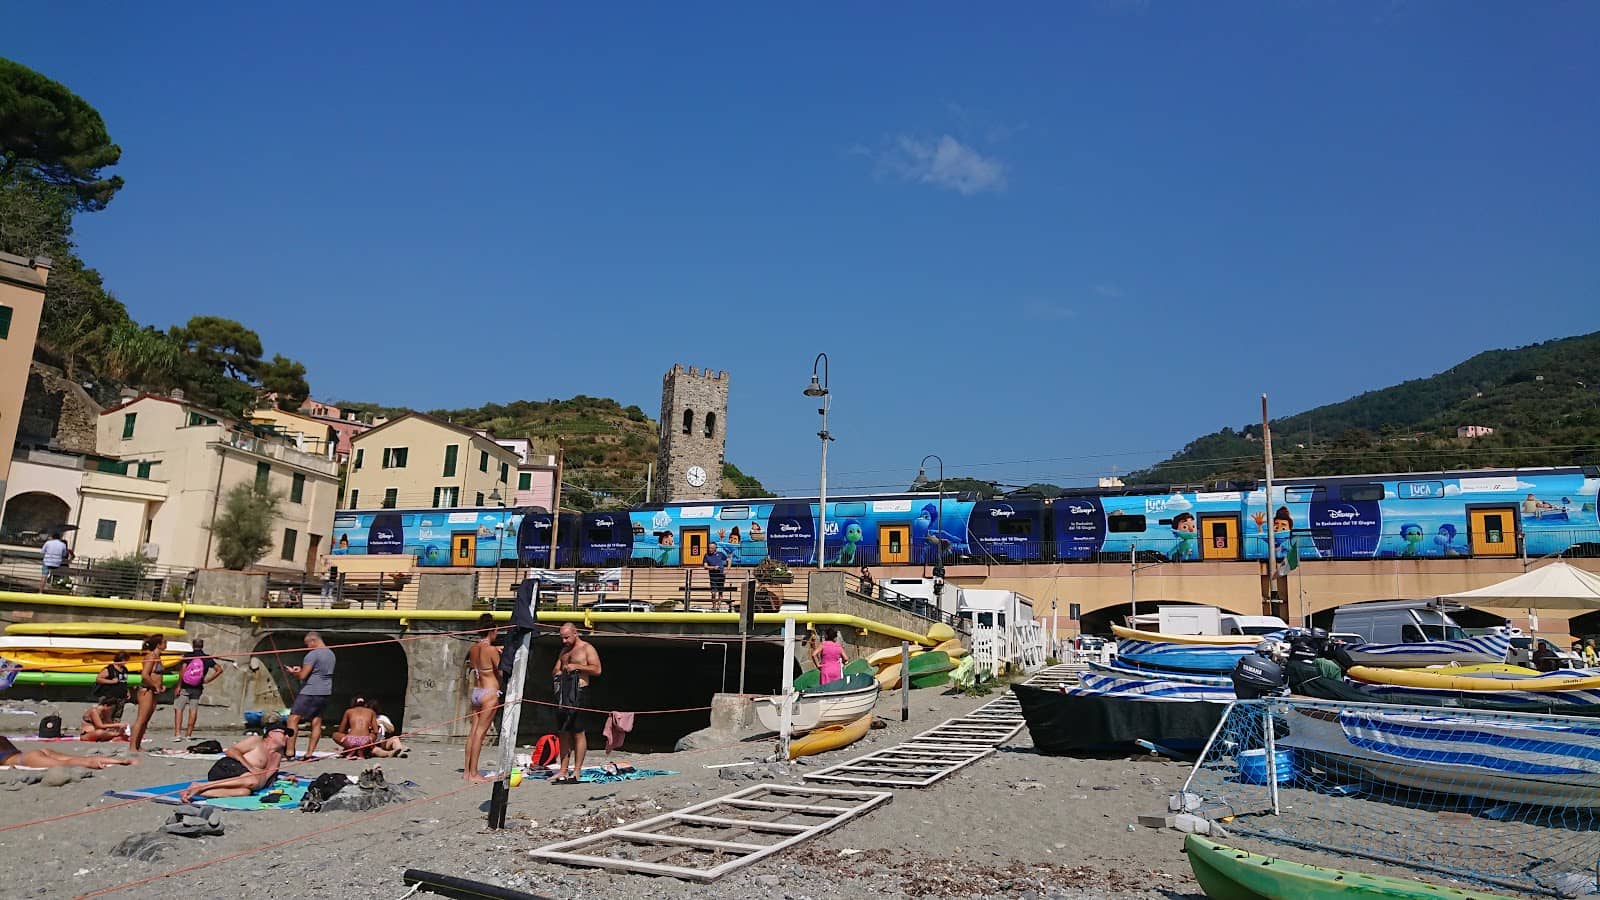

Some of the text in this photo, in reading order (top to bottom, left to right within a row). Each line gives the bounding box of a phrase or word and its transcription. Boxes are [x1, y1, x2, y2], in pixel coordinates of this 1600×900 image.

[1410, 484, 1431, 497] LUCA
[1069, 504, 1096, 516] Disney+
[1145, 498, 1167, 513] LUCA
[989, 508, 1016, 518] Disney+
[1327, 509, 1360, 520] Disney+
[823, 521, 840, 534] UCA
[1242, 664, 1263, 676] YAMAHA
